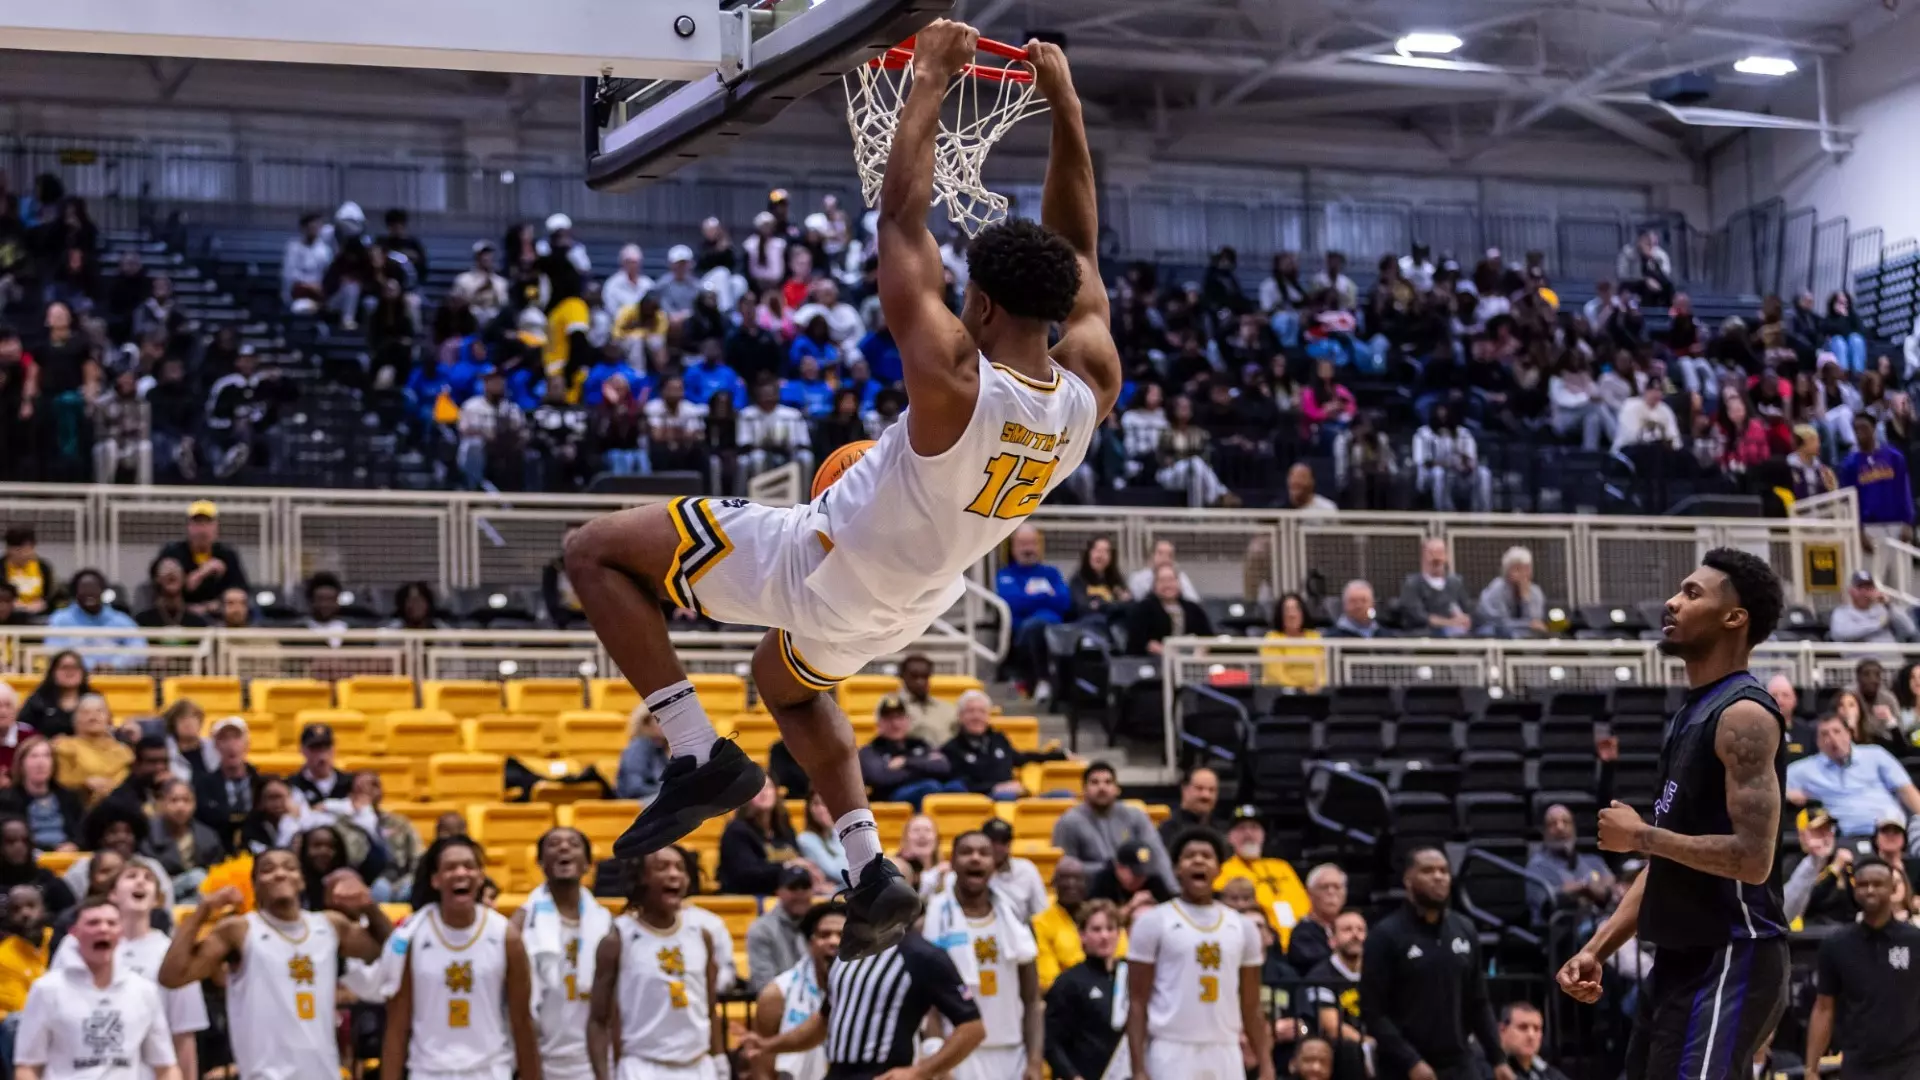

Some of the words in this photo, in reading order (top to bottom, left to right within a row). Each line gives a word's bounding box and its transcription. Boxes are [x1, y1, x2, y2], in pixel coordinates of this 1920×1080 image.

[1000, 421, 1056, 452] SMITH
[963, 452, 1060, 519] 12
[563, 974, 592, 1001] 1
[1200, 975, 1219, 1004] 3
[295, 992, 315, 1020] 0
[448, 999, 470, 1028] 2
